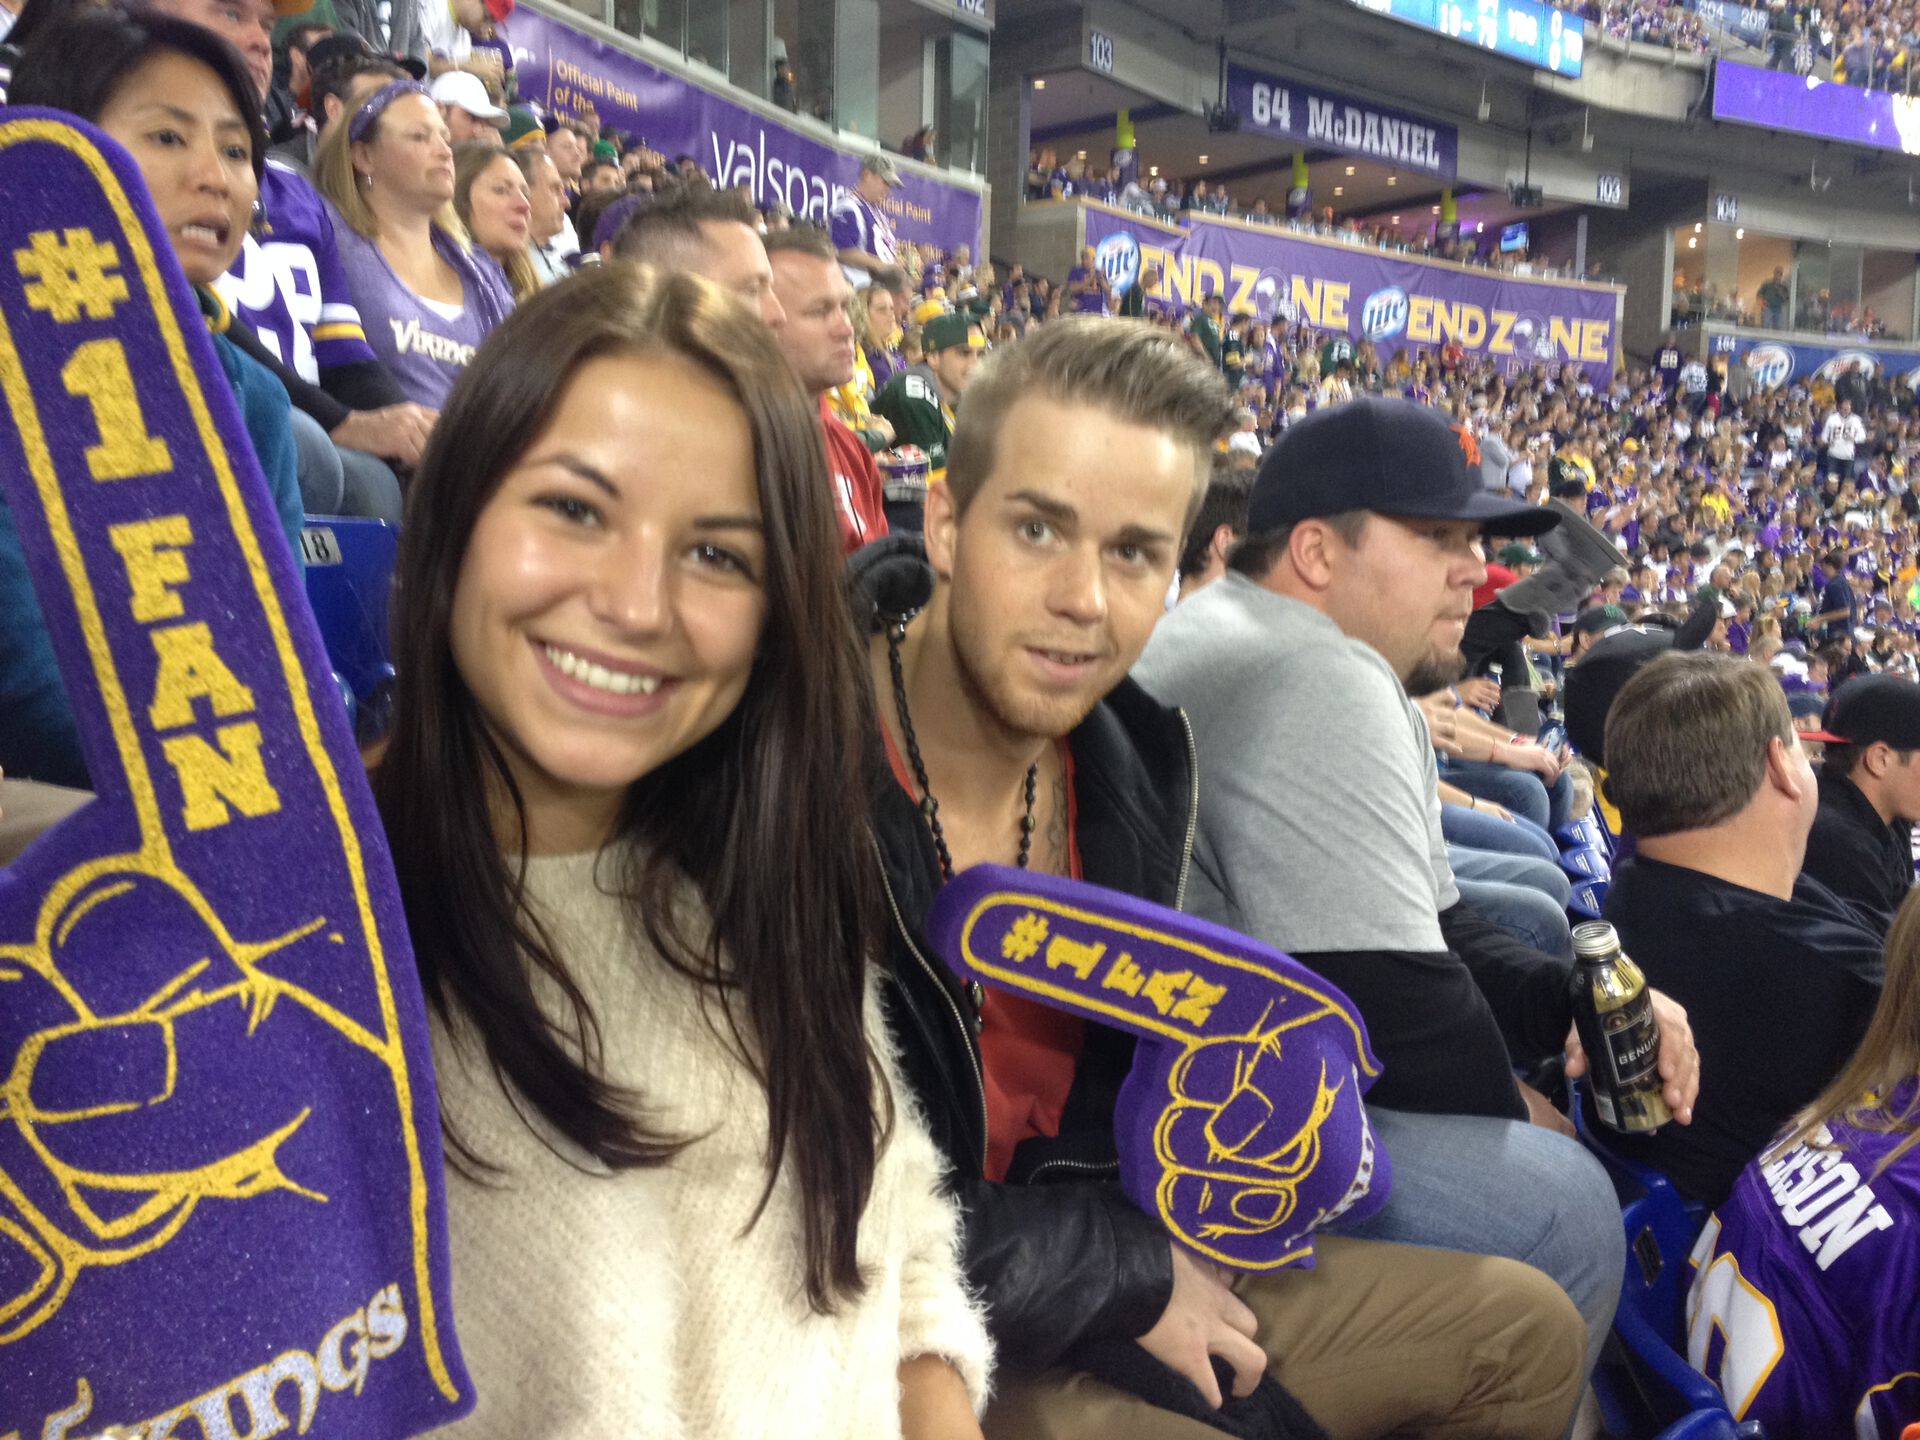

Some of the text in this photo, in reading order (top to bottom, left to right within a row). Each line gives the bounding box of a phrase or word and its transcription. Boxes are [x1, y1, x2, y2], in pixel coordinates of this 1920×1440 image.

[1091, 32, 1113, 74] 103
[554, 86, 570, 106] of
[556, 59, 639, 113] Official Paint
[1252, 82, 1440, 170] 64 McDANIEL
[108, 514, 281, 831] FAN
[1102, 952, 1228, 1028] FAN
